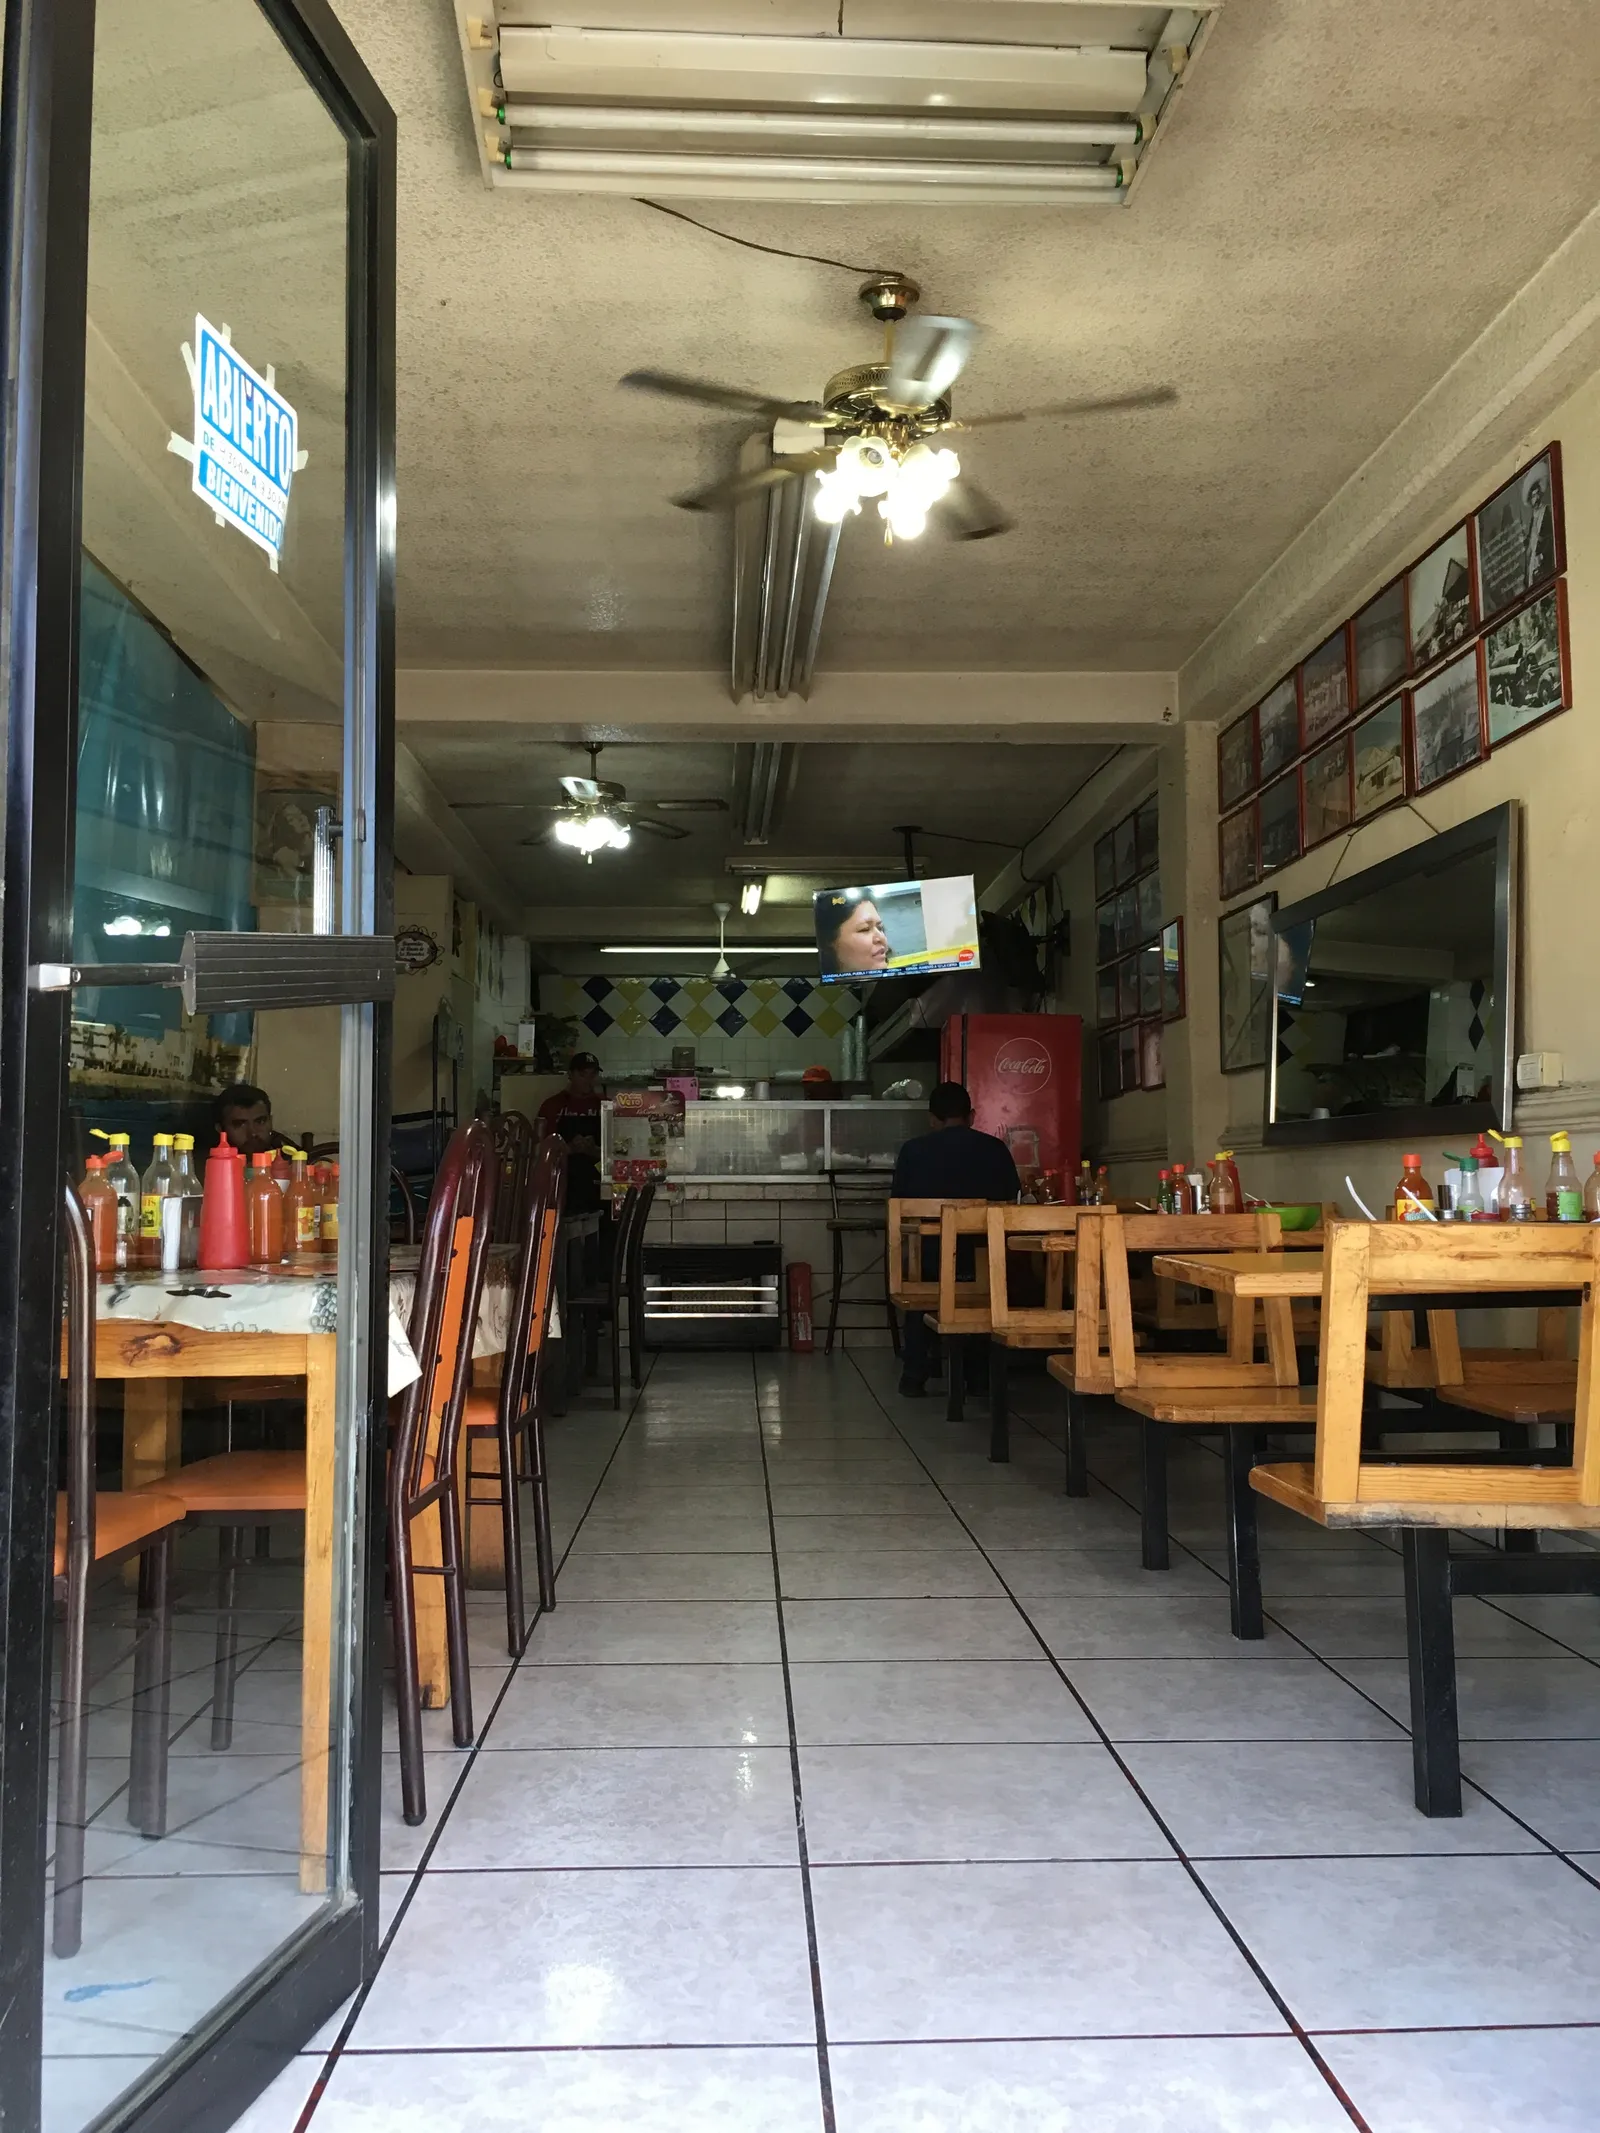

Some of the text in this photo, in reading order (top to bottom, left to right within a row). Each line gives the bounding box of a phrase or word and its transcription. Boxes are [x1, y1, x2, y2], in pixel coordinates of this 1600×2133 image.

[203, 340, 292, 490] ABIERTO
[203, 430, 215, 452] DE
[206, 458, 282, 550] BIENVENIDO
[998, 1057, 1047, 1074] Coca-Cola
[619, 1095, 642, 1107] Vero
